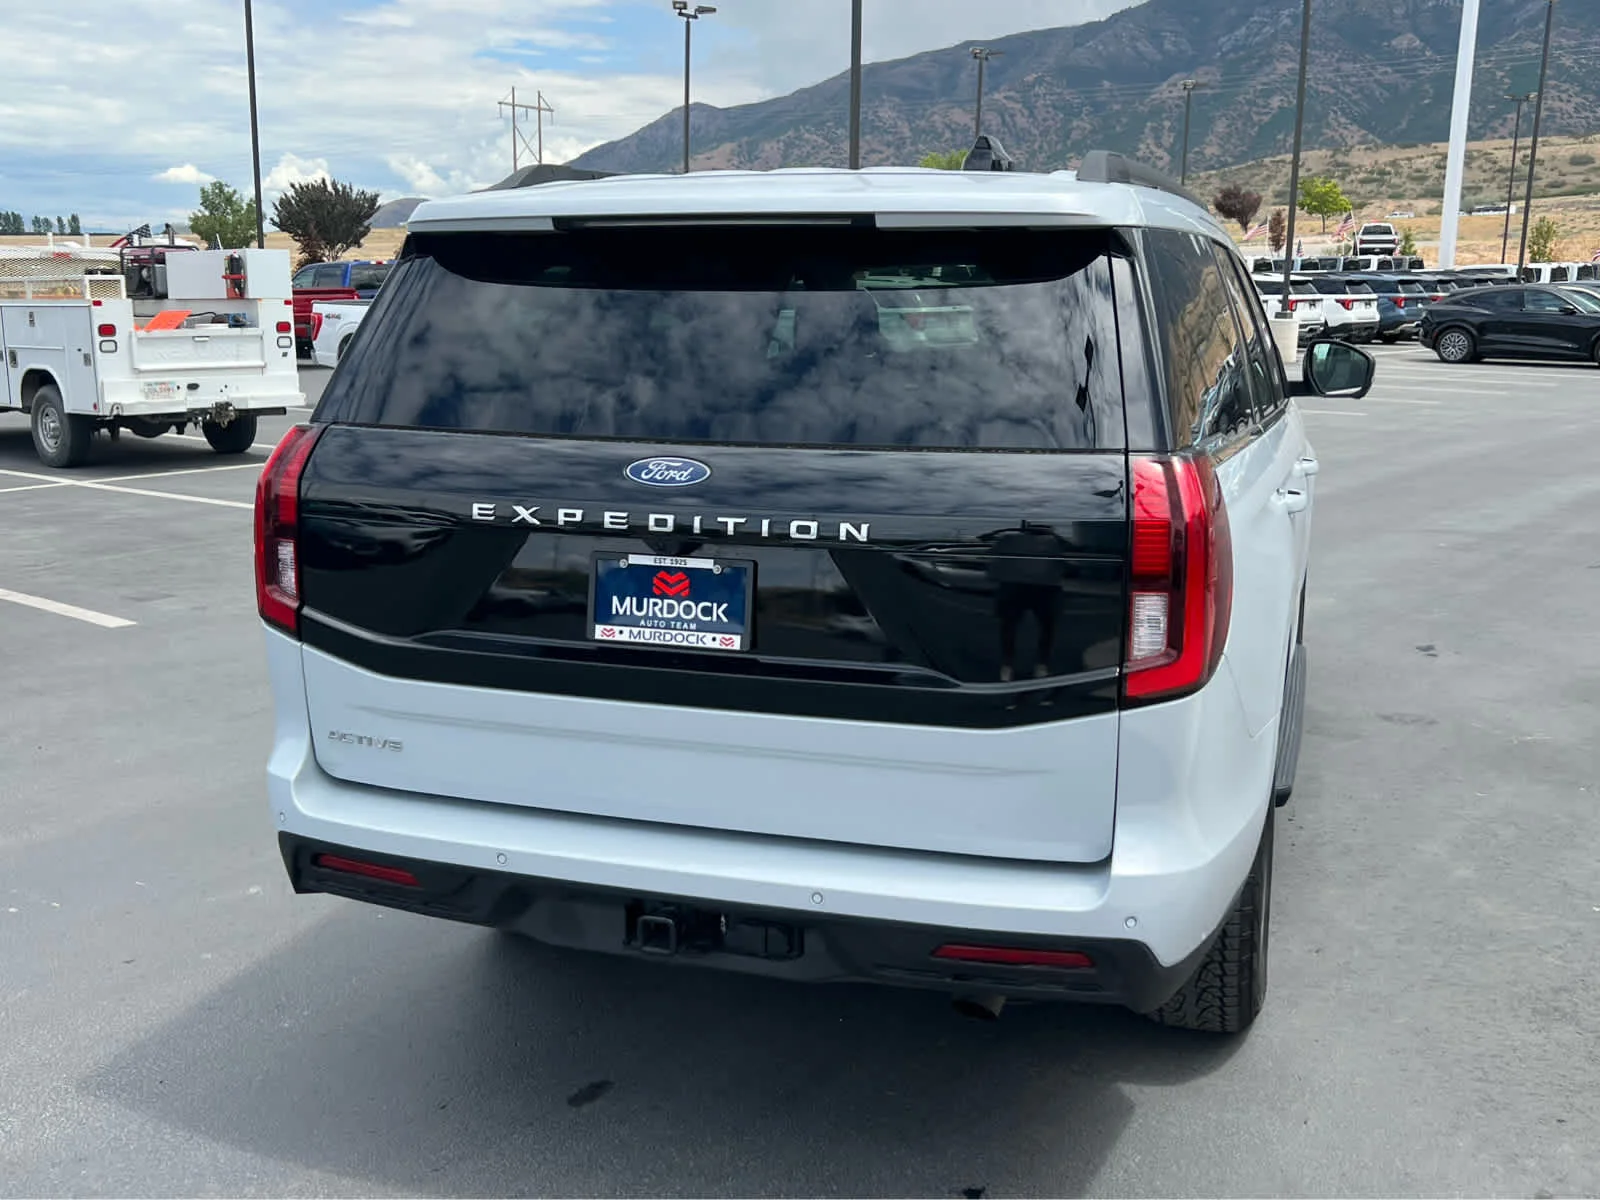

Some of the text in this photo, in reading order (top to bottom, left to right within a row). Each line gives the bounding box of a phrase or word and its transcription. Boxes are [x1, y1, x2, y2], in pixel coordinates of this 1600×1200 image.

[641, 460, 694, 481] Ford
[471, 502, 870, 543] EXPEDITION
[612, 595, 728, 622] MURDOCK
[639, 619, 697, 631] AUTO TEAM
[628, 629, 707, 645] MURDOCK
[328, 730, 403, 752] ACTIVE
